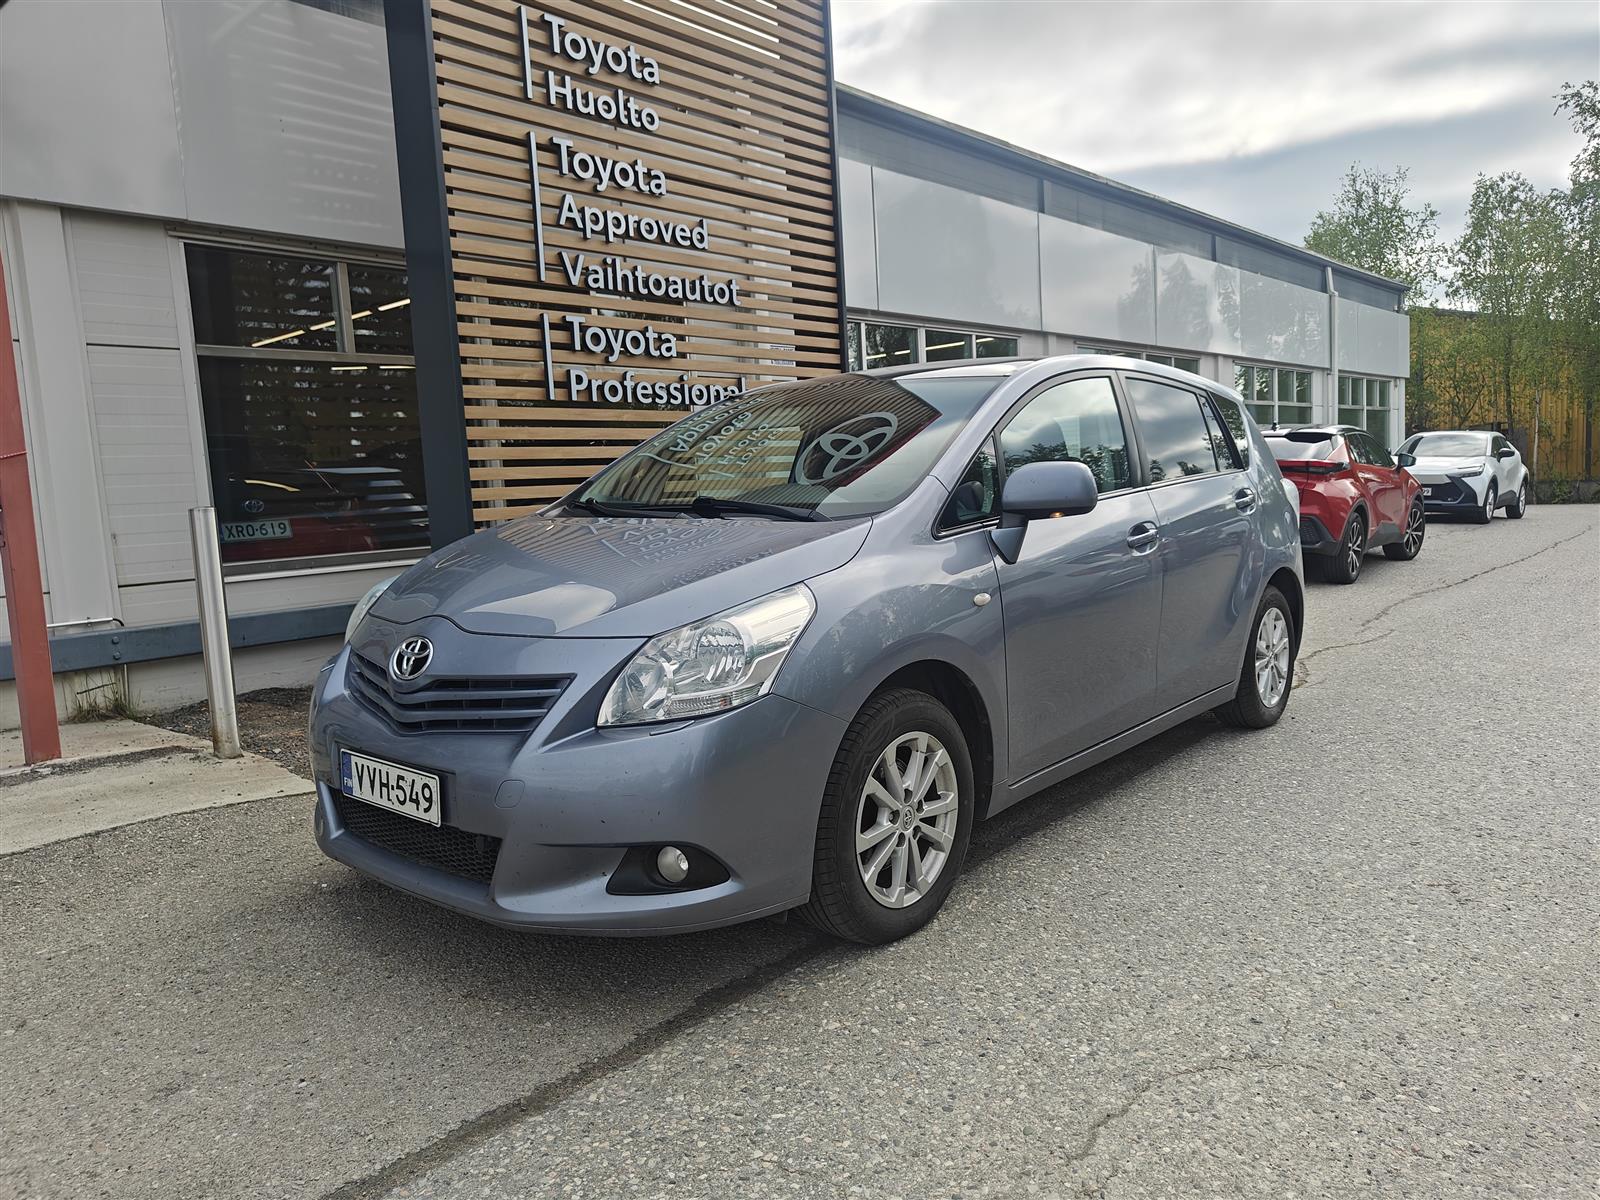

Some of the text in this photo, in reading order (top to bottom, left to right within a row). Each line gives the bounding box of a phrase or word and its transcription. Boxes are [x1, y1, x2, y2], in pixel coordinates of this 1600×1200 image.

[543, 12, 661, 85] Toyota
[545, 70, 660, 132] Huolto
[552, 136, 667, 196] Toyota
[557, 193, 709, 250] Approved
[559, 251, 742, 306] Vaihtoautot
[565, 315, 678, 363] Toyota
[354, 761, 433, 814] VVH-549
